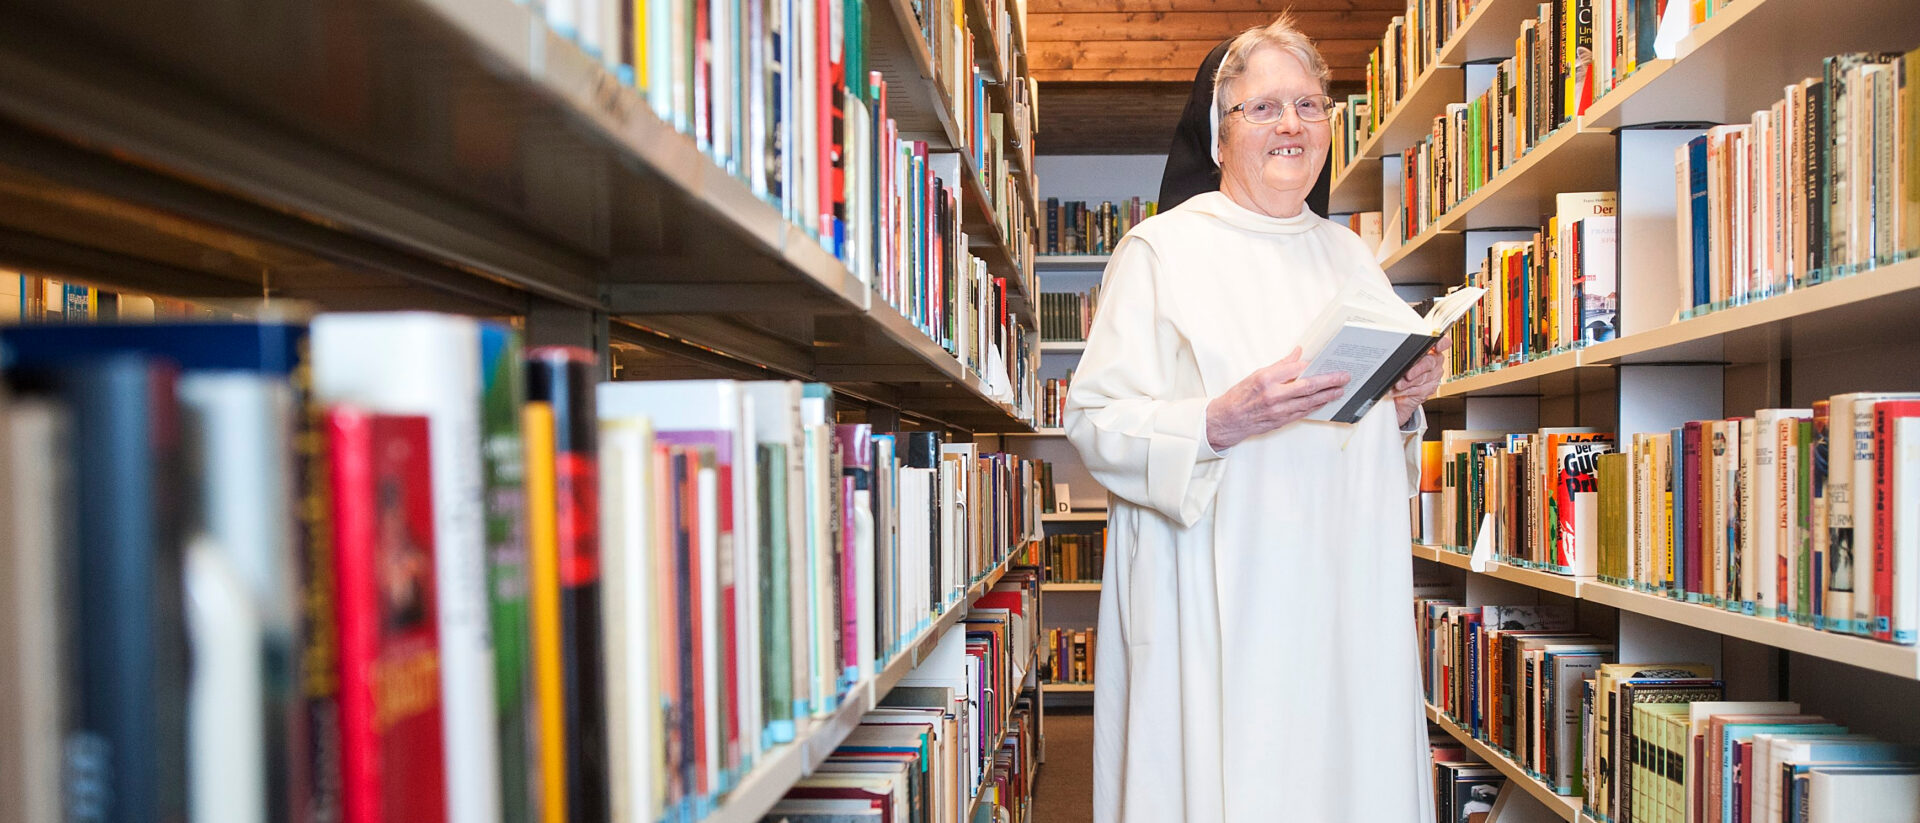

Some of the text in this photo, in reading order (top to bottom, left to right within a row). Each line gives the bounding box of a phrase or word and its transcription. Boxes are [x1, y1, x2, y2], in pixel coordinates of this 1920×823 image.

[1792, 93, 1801, 130] Morgen
[1807, 96, 1817, 172] JESUSZEUGE
[1808, 176, 1816, 200] DER
[1593, 204, 1613, 214] Der
[1779, 424, 1788, 530] Die Mehrheit bin ich!
[1059, 502, 1068, 512] D
[1740, 458, 1749, 549] Steckenpferde
